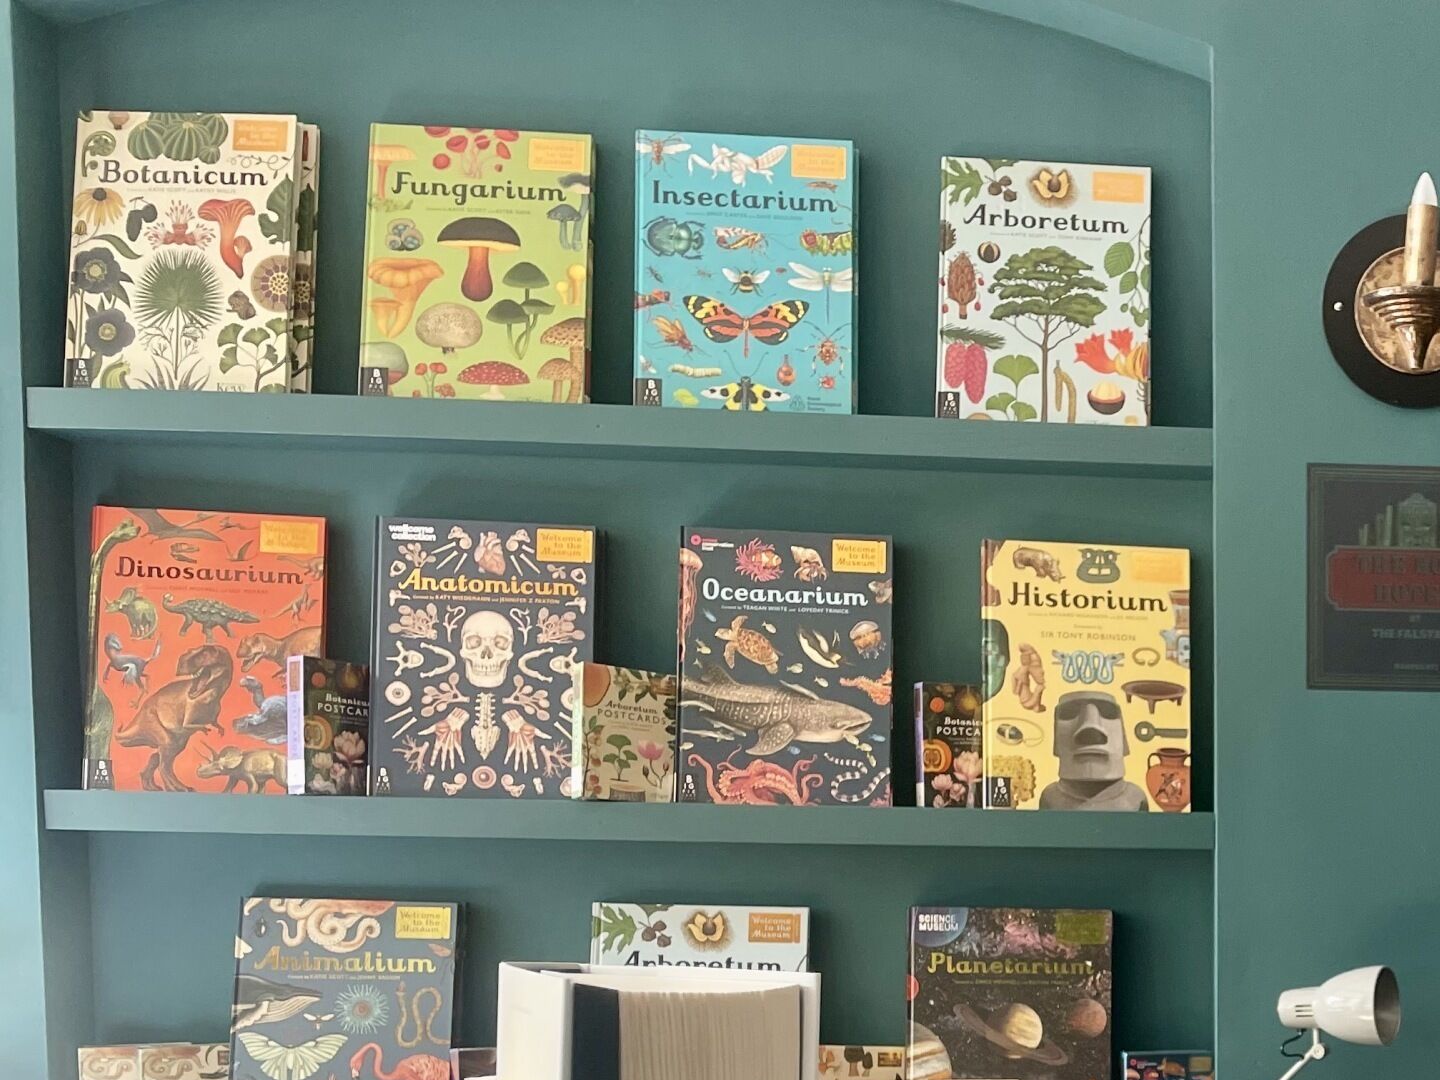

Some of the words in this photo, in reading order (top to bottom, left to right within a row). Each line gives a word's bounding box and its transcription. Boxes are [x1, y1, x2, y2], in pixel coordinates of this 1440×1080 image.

[98, 159, 268, 187] Botanicum
[391, 171, 567, 206] Fungarium
[653, 180, 838, 213] Insectarium
[963, 203, 1129, 234] Arboretum
[836, 543, 876, 553] Welcome
[114, 555, 304, 585] Dinosaurium
[398, 567, 579, 597] Anatomicum
[702, 577, 869, 606] Oceanarium
[1008, 581, 1168, 613] Historium
[1087, 633, 1137, 642] ROBINSON
[597, 708, 667, 725] POSTCARDS
[918, 913, 957, 923] SCIENCE
[918, 922, 960, 932] MUSEUM
[254, 945, 437, 973] Animalium
[927, 951, 1095, 976] Planetarium
